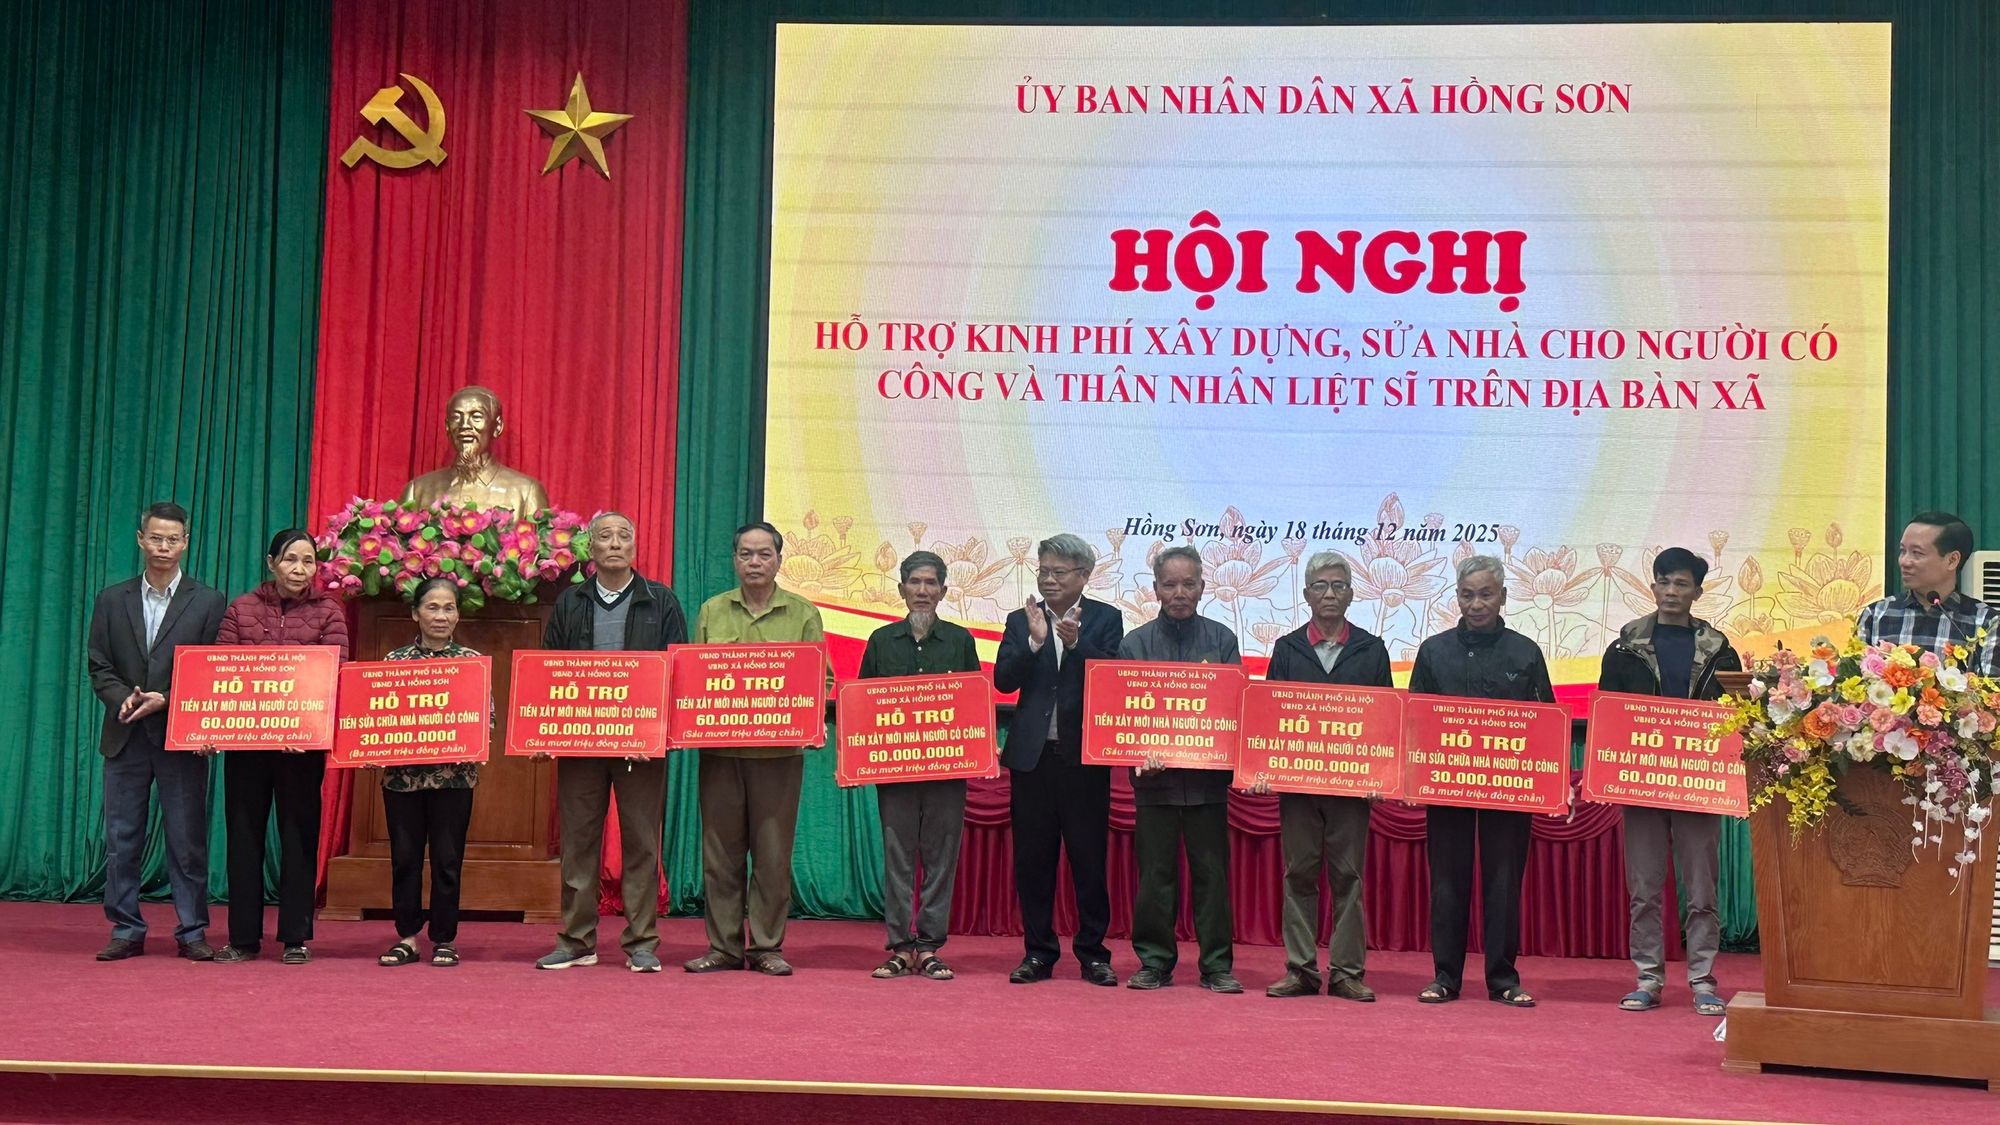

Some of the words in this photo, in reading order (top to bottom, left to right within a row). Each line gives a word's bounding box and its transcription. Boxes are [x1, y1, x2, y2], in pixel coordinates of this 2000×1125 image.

[1016, 76, 1065, 114] ỦY
[1075, 85, 1148, 113] BAN
[1161, 76, 1265, 114] NHÂN
[1277, 77, 1357, 113] DÂN
[1368, 78, 1418, 114] XÃ
[1431, 76, 1544, 113] HỒNG
[1555, 81, 1632, 114] SƠN
[1109, 210, 1268, 309] HỘI
[1295, 230, 1526, 311] NGHỊ
[815, 314, 868, 350] HỖ
[879, 321, 956, 359] TRỢ
[964, 325, 1059, 354] KINH
[1071, 319, 1132, 354] PHÍ
[1145, 318, 1222, 356] XÂY
[1232, 323, 1351, 363] DỰNG,
[1361, 320, 1436, 358] SỬA
[1447, 321, 1528, 358] NHÀ
[1540, 329, 1626, 359] CHO
[1636, 322, 1768, 360] NGƯỜI
[1781, 323, 1838, 361] CÓ
[878, 362, 985, 400] CÔNG
[994, 365, 1044, 402] VÀ
[1055, 365, 1164, 404] THÂN
[1169, 367, 1275, 405] NHÂN
[1285, 375, 1373, 413] LIỆT
[1384, 370, 1416, 407] SĨ
[1429, 369, 1531, 407] TRÊN
[1542, 379, 1612, 416] ĐỊA
[1621, 372, 1700, 409] BÀN
[1712, 373, 1766, 410] XÃ
[1123, 513, 1176, 542] Hồng
[1181, 518, 1224, 540] Sơn,
[1231, 519, 1277, 544] ngày
[1285, 520, 1306, 539] 18
[1312, 520, 1367, 545] tháng
[1376, 522, 1396, 541] 12
[1403, 523, 1445, 542] năm
[1452, 523, 1499, 542] 2025
[212, 675, 243, 694] HỖ
[250, 678, 294, 696] TRỢ
[549, 681, 579, 700] HỖ
[585, 684, 629, 703] TRỢ
[705, 673, 735, 691] HỖ
[742, 674, 785, 693] TRỢ
[369, 690, 399, 710] HỖ
[406, 690, 449, 710] TRỢ
[1124, 692, 1155, 710] HỖ
[1162, 696, 1207, 715] TRỢ
[200, 716, 299, 729] 60.000.000đ
[696, 712, 791, 725] 60.000.000đ
[875, 707, 905, 727] HỖ
[911, 706, 955, 725] TRỢ
[359, 729, 456, 745] 30.000.000đ
[538, 722, 633, 735] 60.000.000đ
[1278, 715, 1309, 734] HỖ
[1317, 719, 1363, 740] TRỢ
[1115, 732, 1213, 747] 60.000.000đ
[1440, 729, 1472, 748] HỖ
[1479, 734, 1526, 755] TRỢ
[1630, 729, 1663, 748] HỖ
[869, 745, 963, 762] 60.000.000đ
[1268, 756, 1369, 774] 60.000.000đ
[1430, 770, 1533, 789] 30.000.000đ
[1618, 769, 1725, 791] 60.000.000đ
